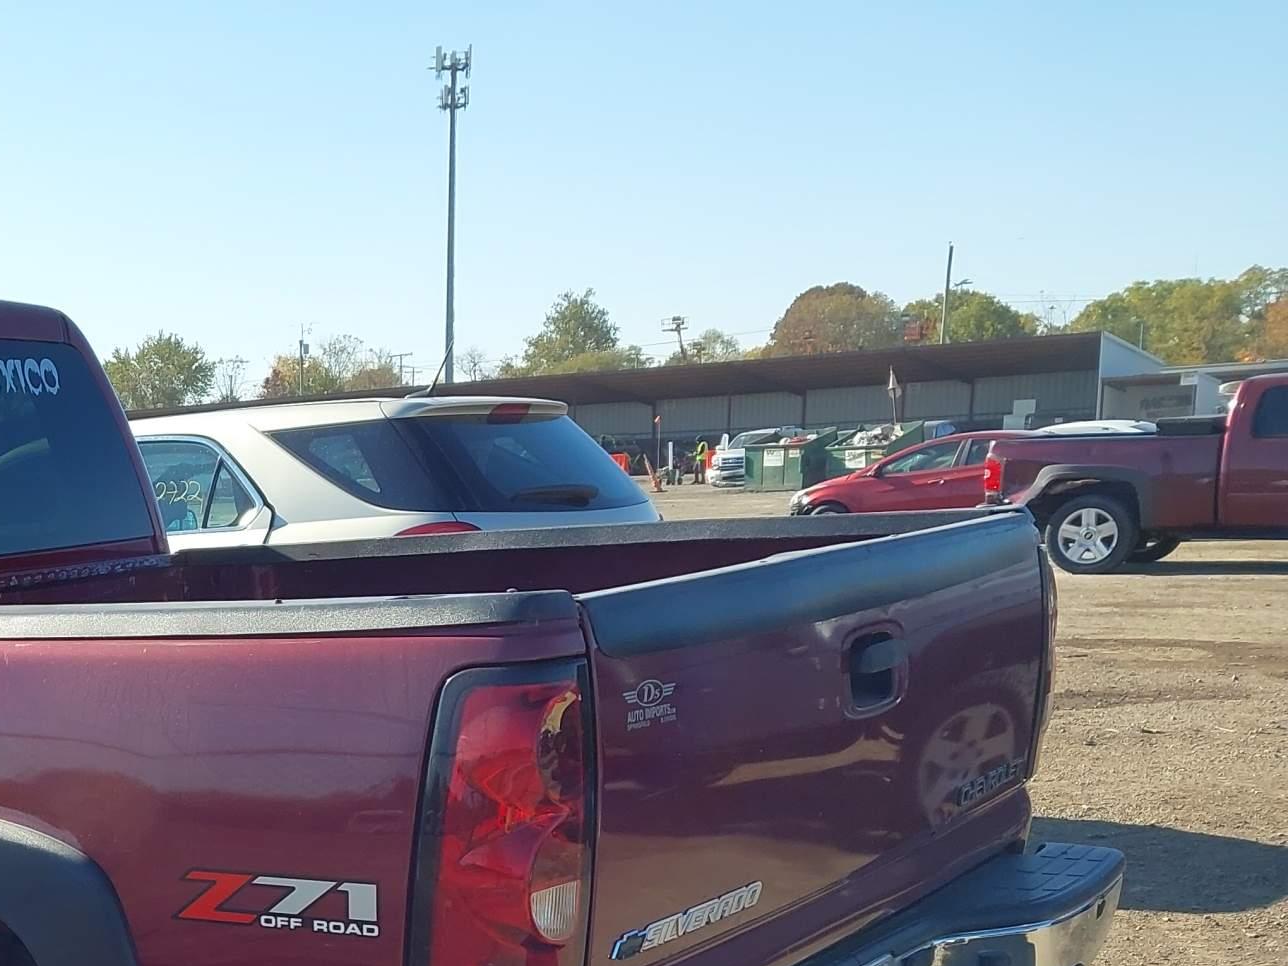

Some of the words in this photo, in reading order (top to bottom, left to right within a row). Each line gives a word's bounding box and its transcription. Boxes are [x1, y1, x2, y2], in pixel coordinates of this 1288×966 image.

[178, 870, 378, 924] Z71
[640, 880, 763, 952] SILVERADO
[260, 916, 303, 930] OFF
[313, 920, 379, 937] ROAD
